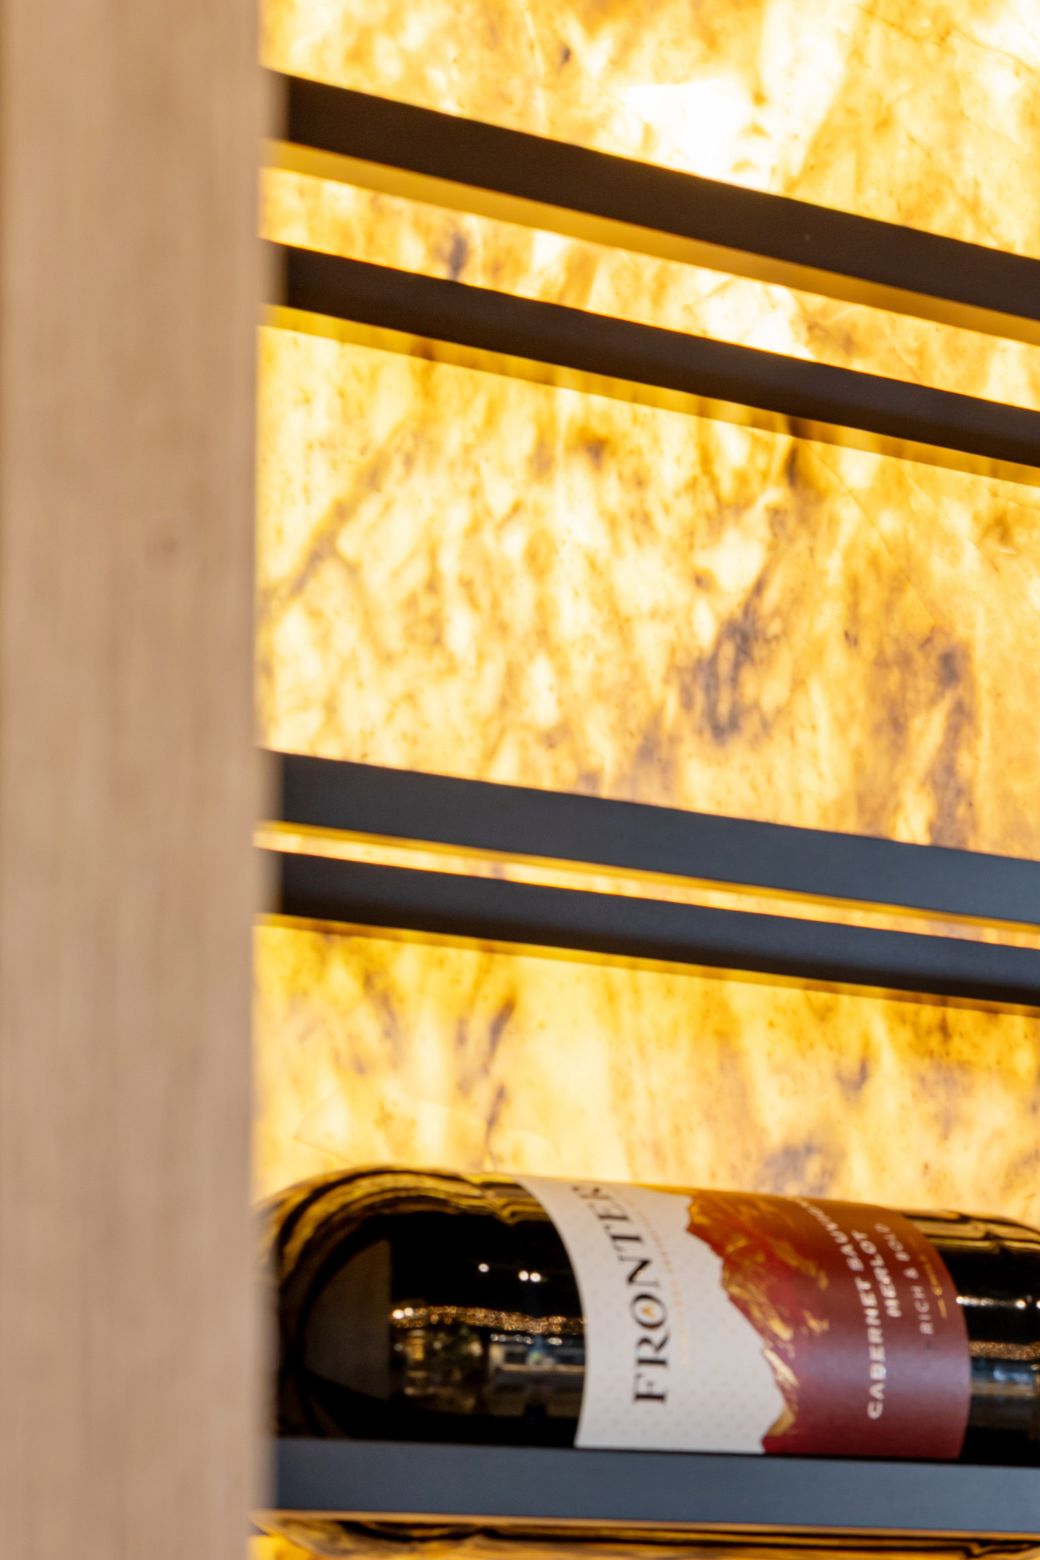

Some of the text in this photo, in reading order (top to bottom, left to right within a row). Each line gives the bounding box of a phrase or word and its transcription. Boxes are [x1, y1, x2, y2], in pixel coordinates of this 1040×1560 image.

[850, 1228, 902, 1319] MERLOT
[910, 1284, 935, 1336] RICH
[854, 1276, 887, 1420] CABERNET
